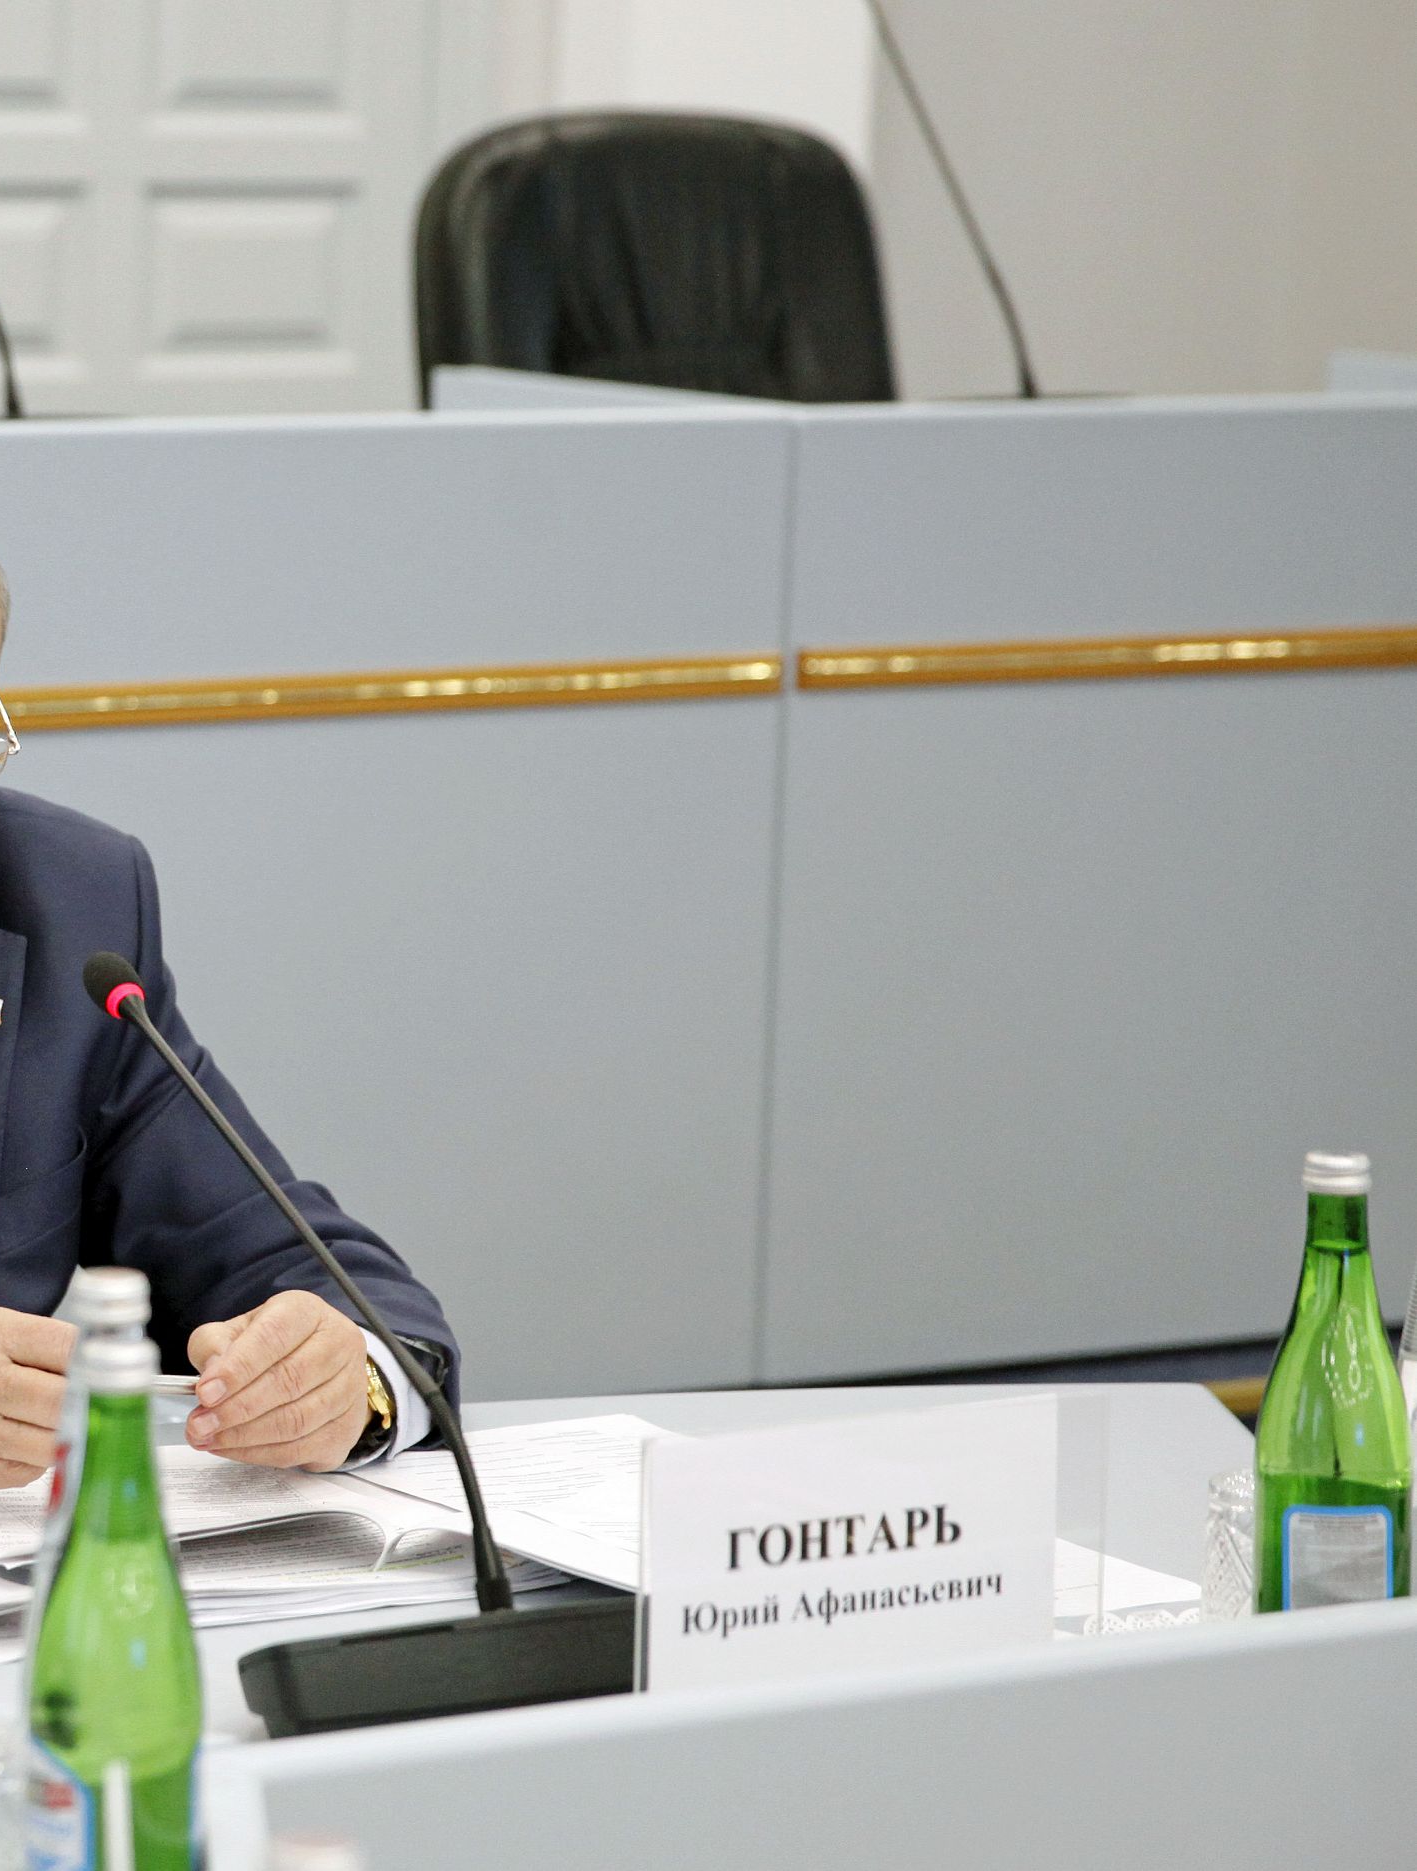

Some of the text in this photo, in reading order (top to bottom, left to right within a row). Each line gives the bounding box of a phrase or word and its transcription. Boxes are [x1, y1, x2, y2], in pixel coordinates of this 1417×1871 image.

[726, 1503, 963, 1571] ГОНТАРЬ
[682, 1573, 1003, 1638] Юрий Афанасьевич
